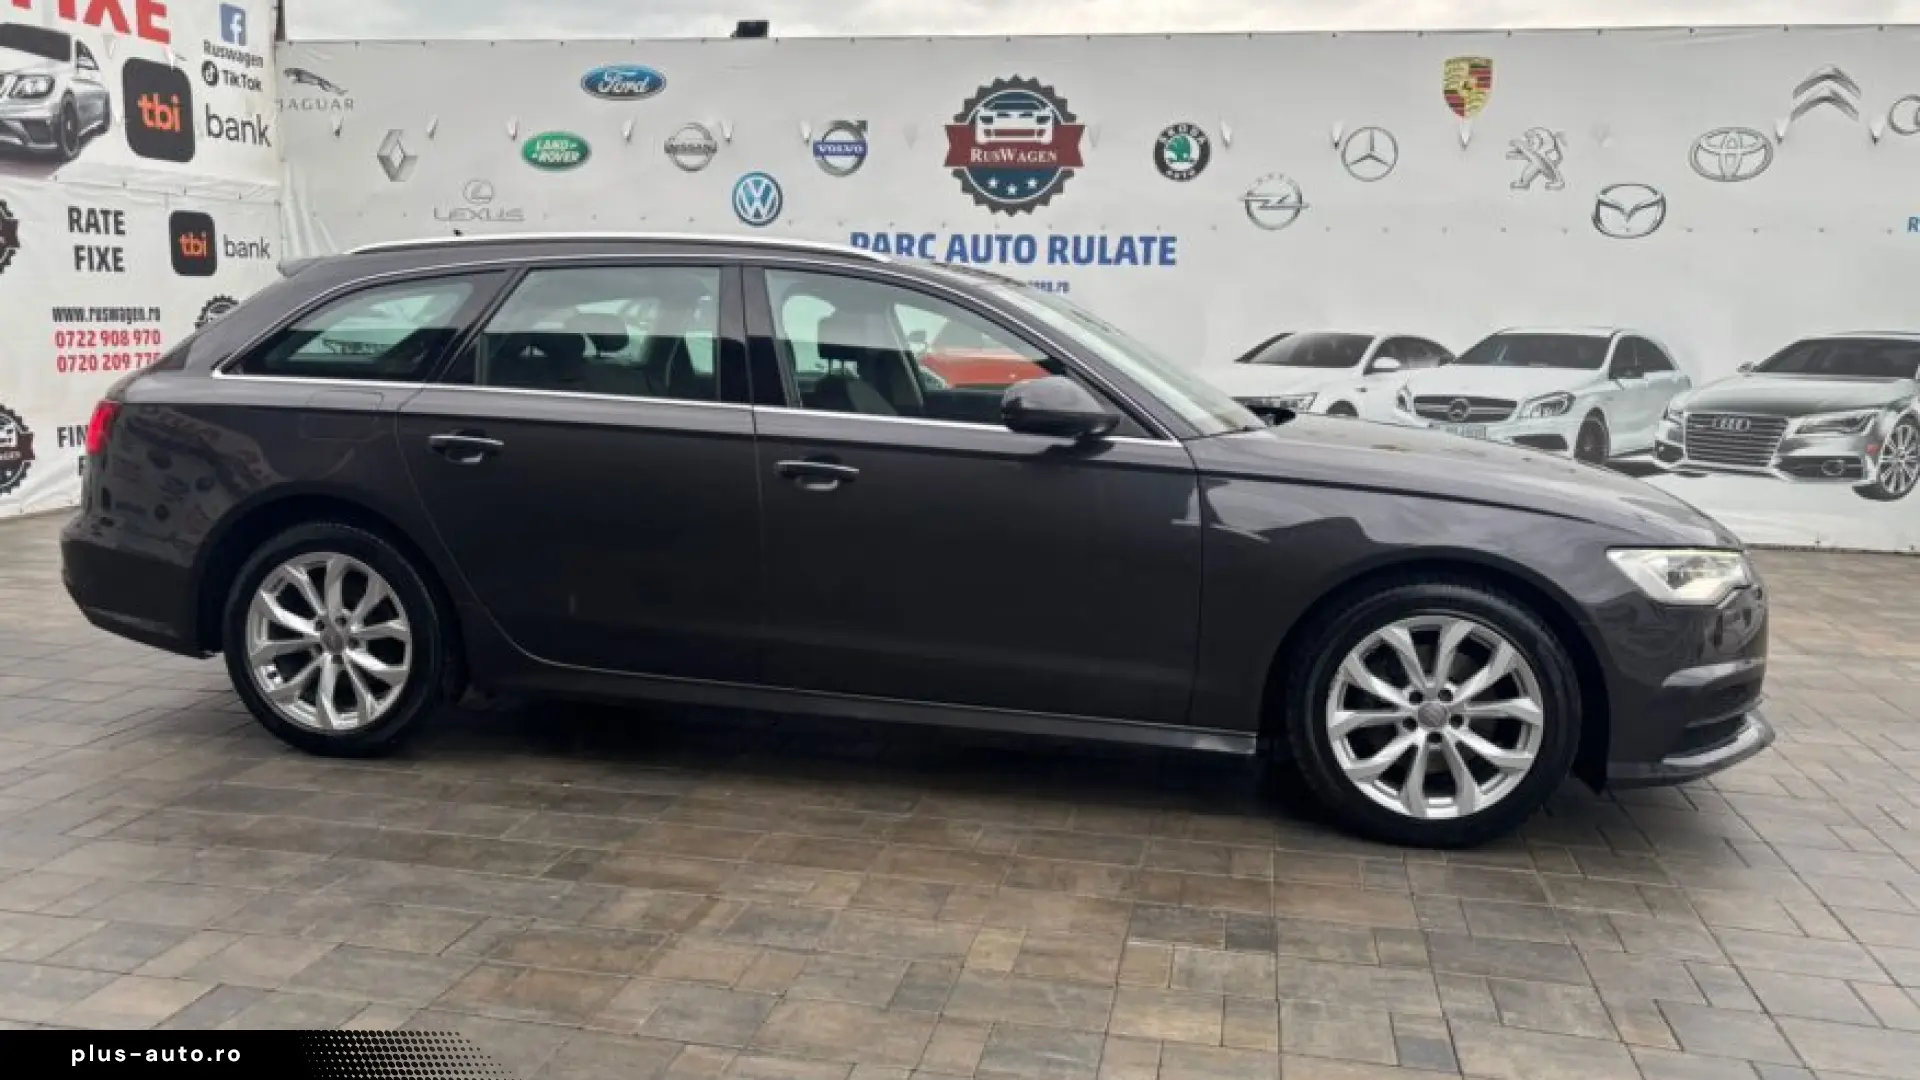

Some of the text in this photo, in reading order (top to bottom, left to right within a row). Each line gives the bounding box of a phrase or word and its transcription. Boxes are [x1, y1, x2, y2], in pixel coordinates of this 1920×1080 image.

[138, 93, 182, 132] tbi
[205, 103, 272, 147] bank
[67, 206, 126, 235] RATE
[433, 207, 525, 222] LEXUS
[179, 232, 208, 258] tbi
[223, 234, 271, 260] bank
[850, 231, 1178, 266] PARC AUTO RULATE
[73, 245, 125, 273] FIXE
[52, 306, 161, 325] www.ruswagen.ro
[55, 328, 161, 348] 0722 908 970
[56, 354, 98, 373] 0720
[102, 352, 131, 371] 209
